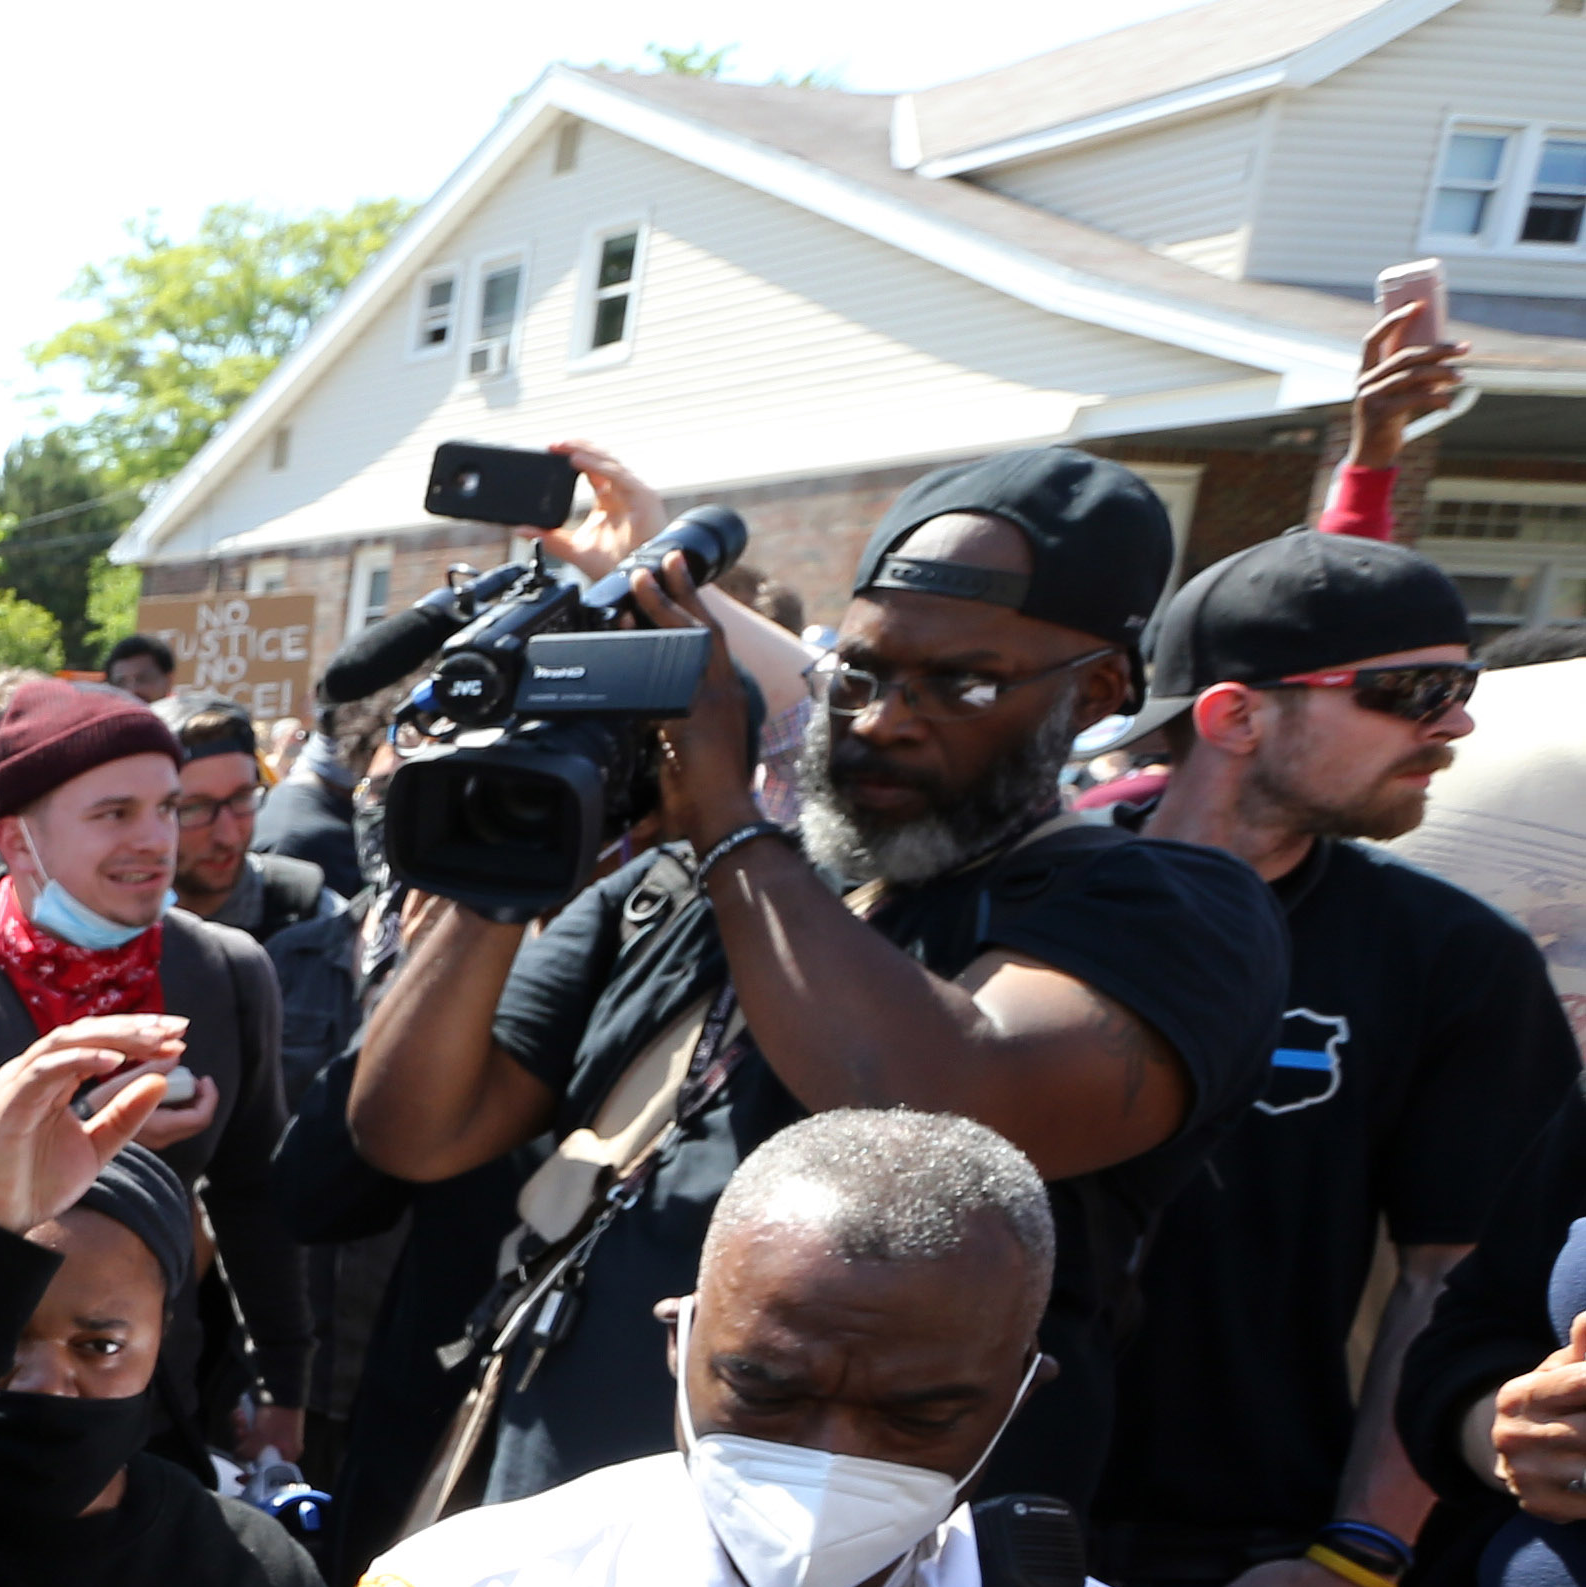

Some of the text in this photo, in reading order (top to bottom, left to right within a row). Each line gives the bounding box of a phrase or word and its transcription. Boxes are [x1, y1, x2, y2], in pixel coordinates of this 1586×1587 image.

[195, 599, 250, 632] NO
[156, 624, 310, 664] JUSTICE
[193, 655, 248, 691] NO
[448, 679, 483, 697] JVC
